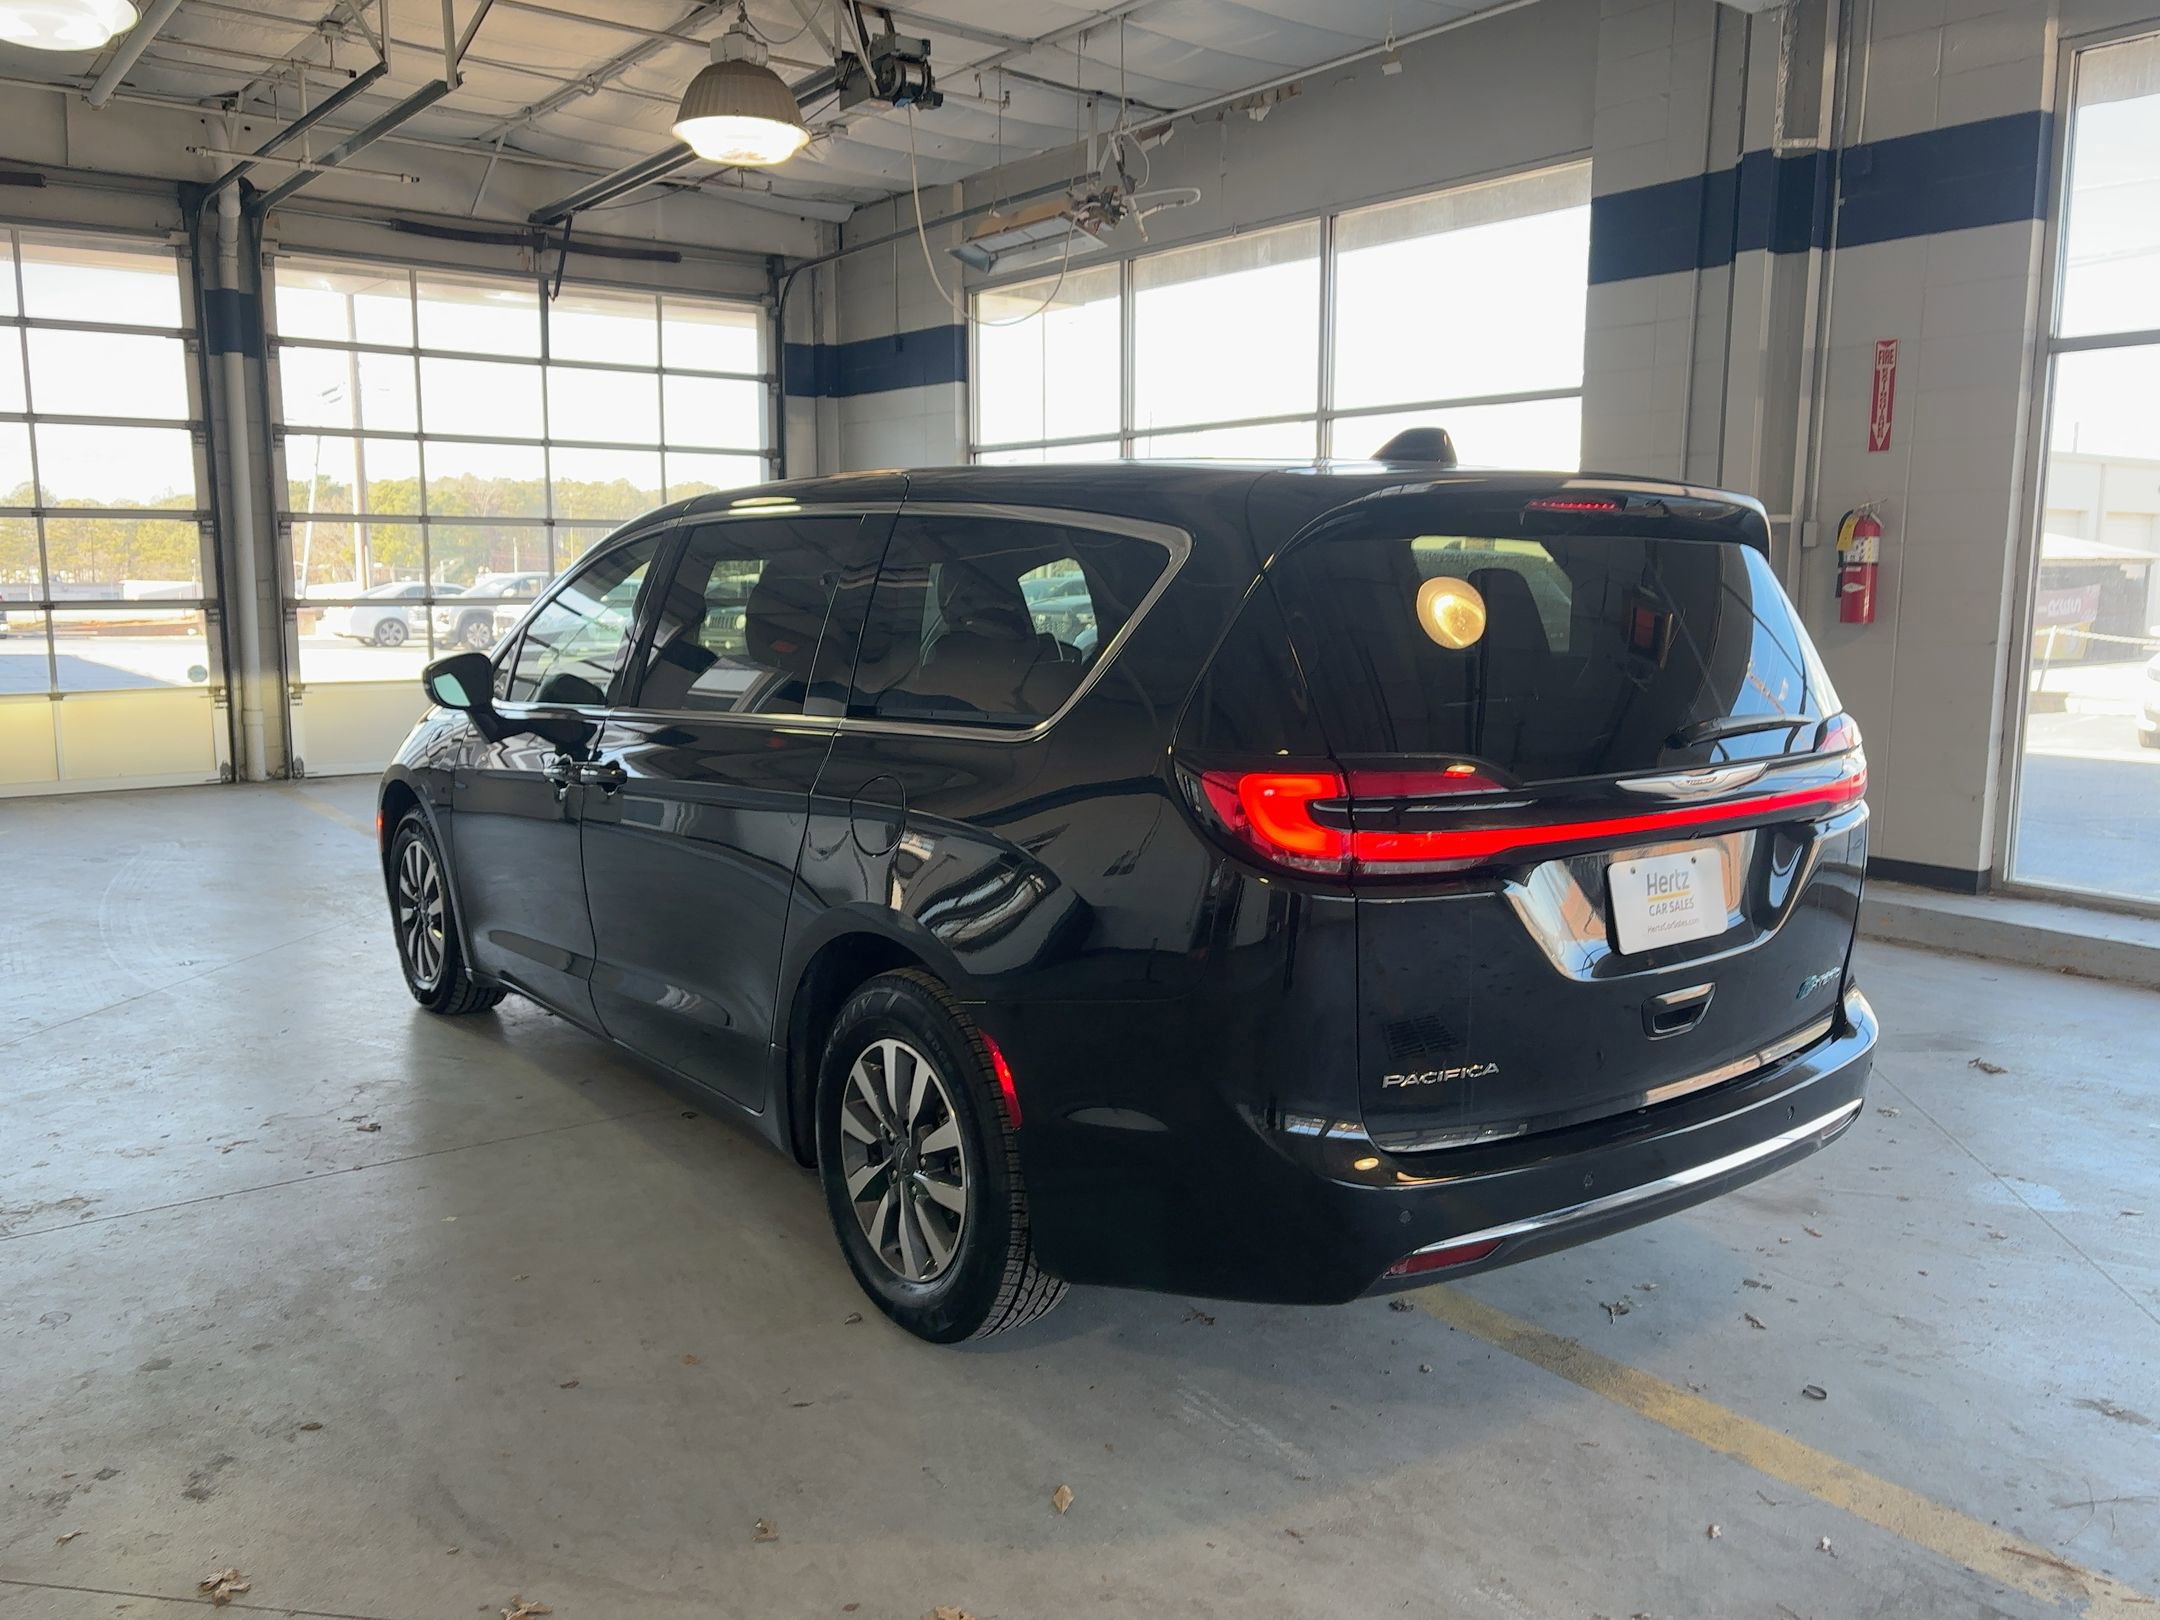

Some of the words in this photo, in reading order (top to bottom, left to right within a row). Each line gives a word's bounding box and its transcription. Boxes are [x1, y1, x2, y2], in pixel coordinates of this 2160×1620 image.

[1878, 349, 1895, 365] FIRE
[1646, 869, 1691, 896] Hertz
[1648, 900, 1668, 917] CAR
[1669, 896, 1695, 914] SALES
[1382, 1062, 1500, 1089] PACIFICA
